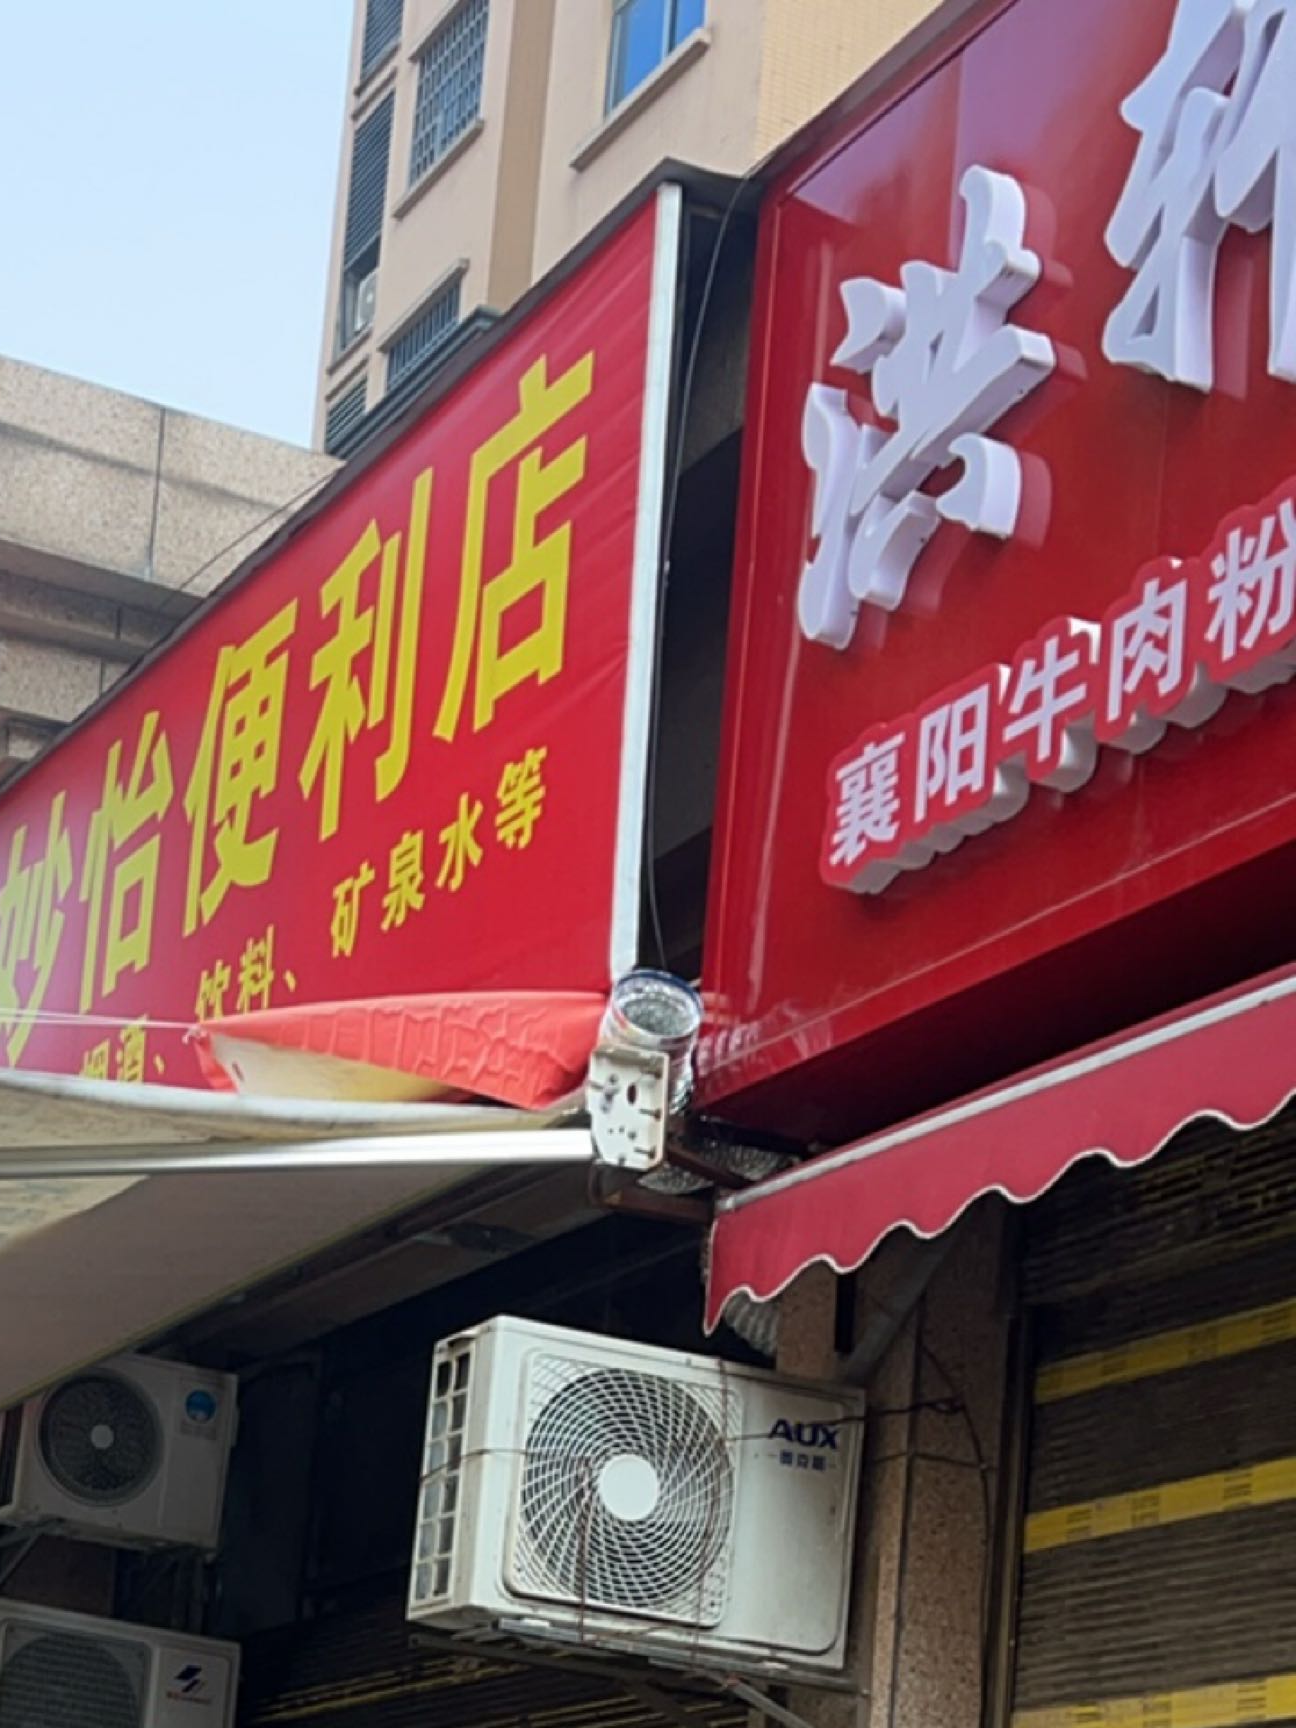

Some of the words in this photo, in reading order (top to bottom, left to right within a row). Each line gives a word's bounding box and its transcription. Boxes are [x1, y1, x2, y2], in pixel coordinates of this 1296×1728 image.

[830, 498, 1296, 867] 襄阳牛肉粉
[768, 1417, 840, 1450] AUX
